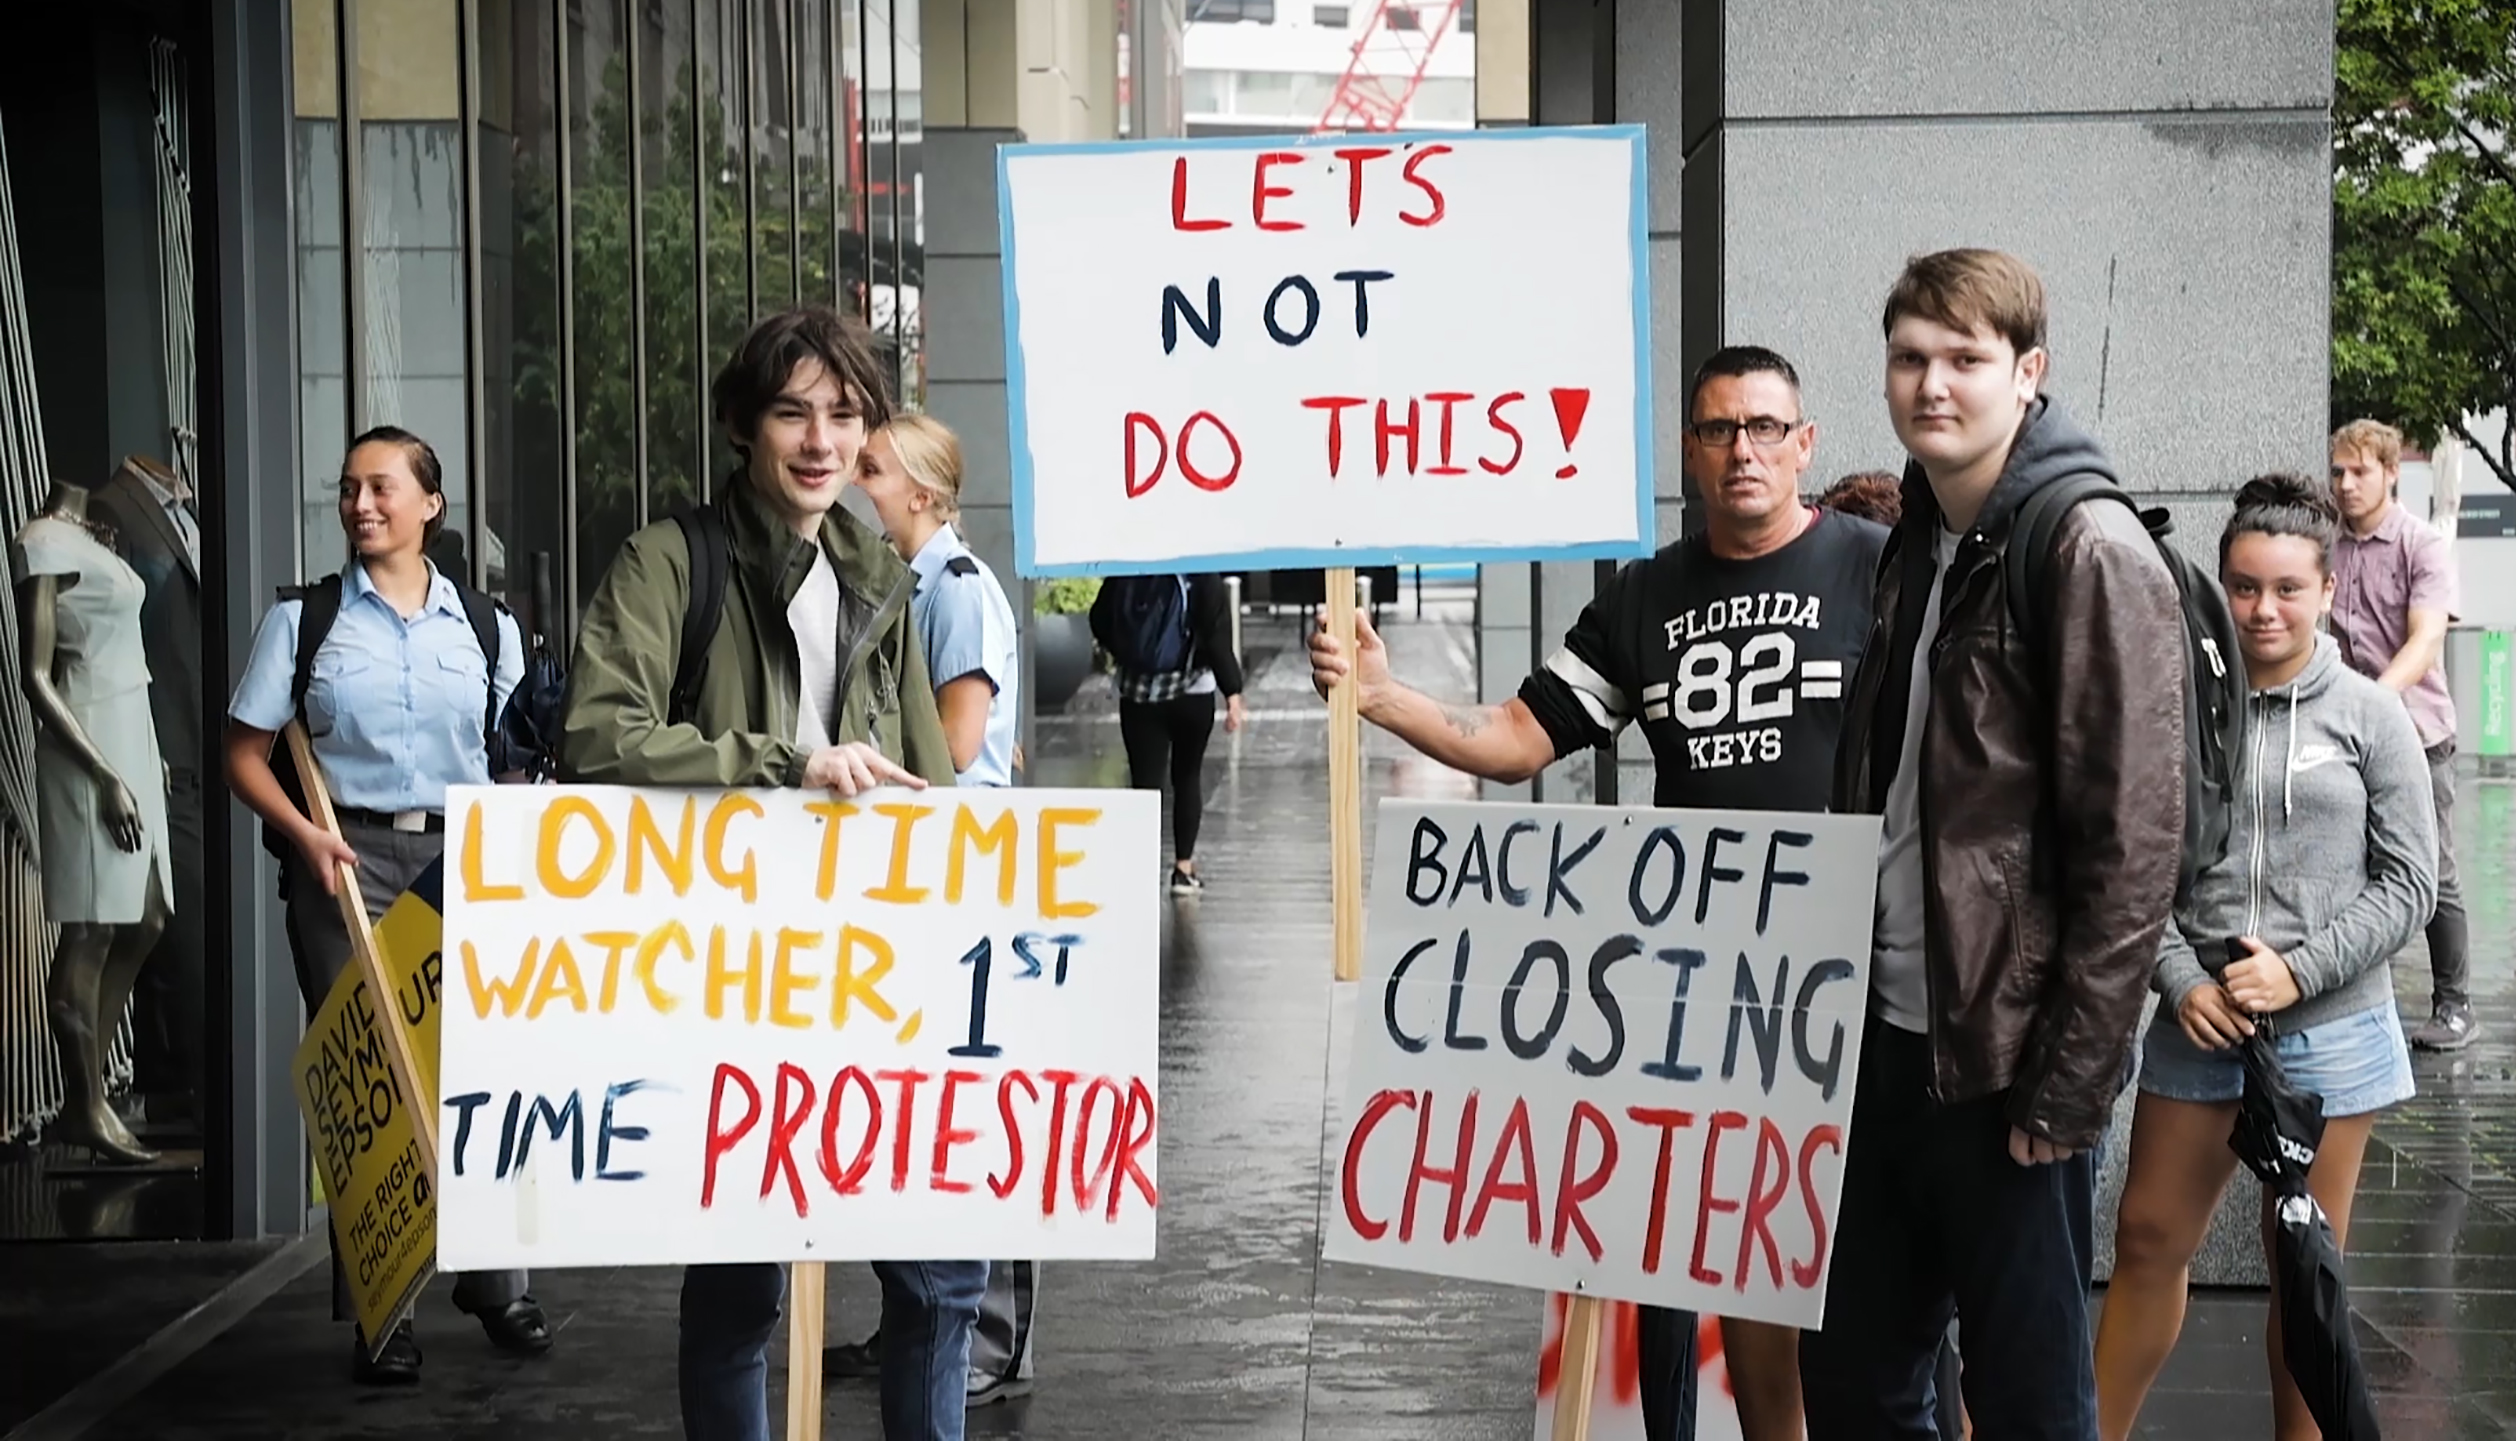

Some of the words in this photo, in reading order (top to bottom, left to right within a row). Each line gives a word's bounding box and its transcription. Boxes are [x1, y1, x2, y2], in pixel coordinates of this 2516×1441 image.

[1172, 143, 1453, 232] LET'S
[1162, 270, 1395, 355] NOT
[1125, 411, 1243, 499] DO
[1301, 388, 1591, 480] THIS!
[1664, 591, 1822, 651] FLORIDA
[1686, 726, 1782, 770] KEYS
[460, 793, 764, 903] LONG
[803, 802, 1104, 919] TIME
[1405, 815, 1607, 918] BACK
[1627, 825, 1814, 935] OFF
[461, 920, 922, 1044] WATCHER,
[947, 932, 1087, 1058] 1ST
[1384, 928, 1857, 1103] CLOSING
[328, 1063, 403, 1198] EPSO
[443, 1079, 682, 1184] TIME
[701, 1062, 1160, 1224] PROTESTOR
[350, 1200, 377, 1254] THE
[358, 1196, 412, 1288] CHOICE
[1341, 1088, 1842, 1293] CHARTERS
